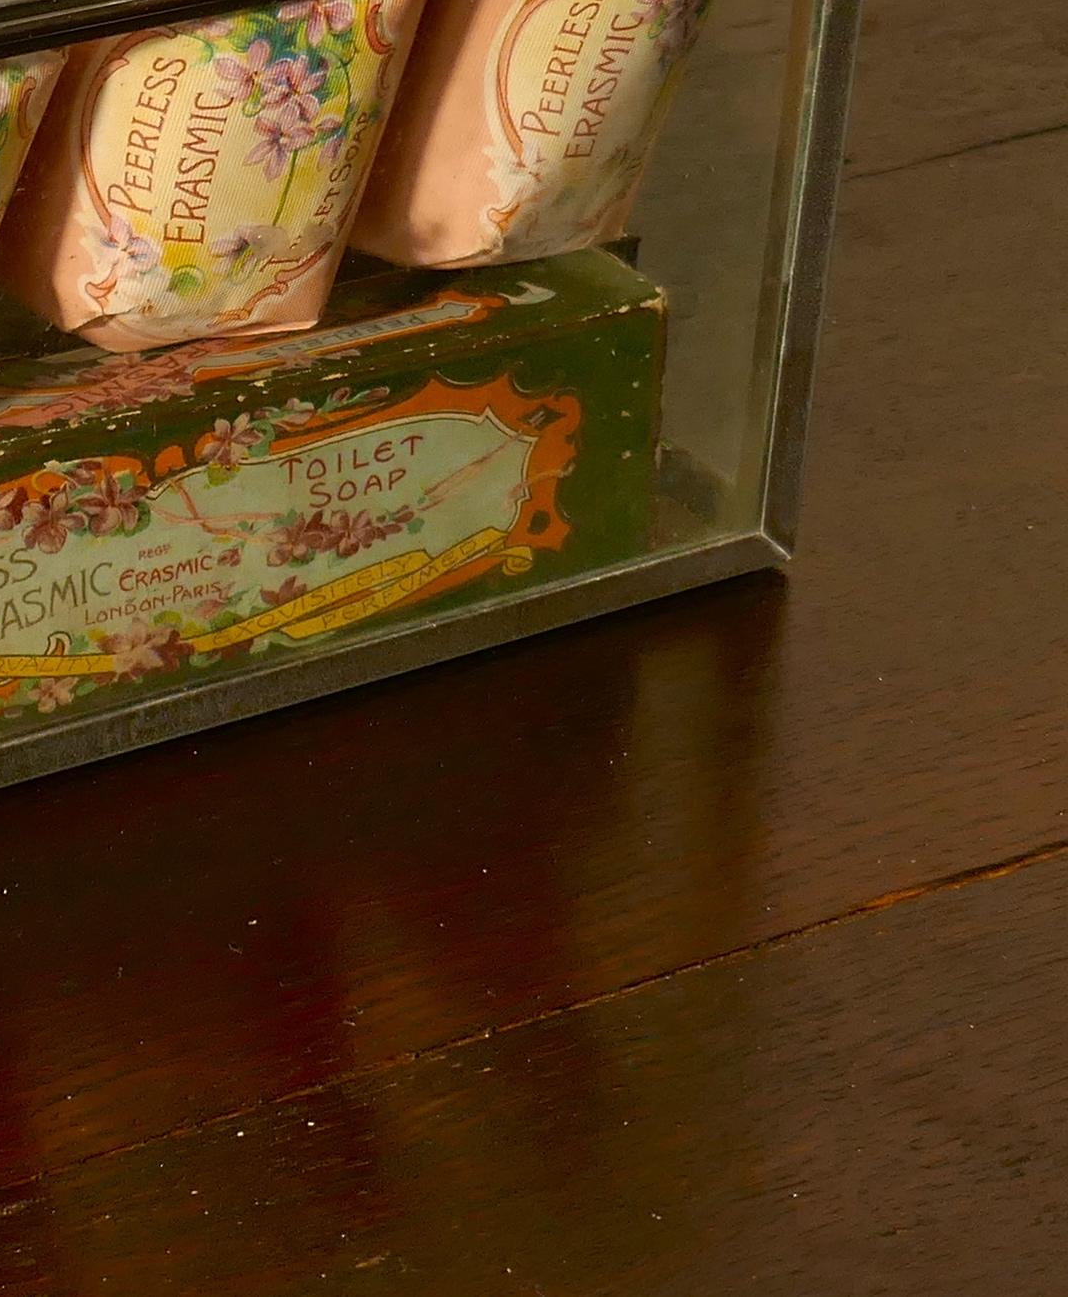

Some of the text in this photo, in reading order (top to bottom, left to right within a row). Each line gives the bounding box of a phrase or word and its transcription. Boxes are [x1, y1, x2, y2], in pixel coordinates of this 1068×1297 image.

[564, 14, 645, 159] ERASMIC
[107, 56, 187, 215] PEERLESS
[163, 91, 236, 246] ERASMIC
[279, 435, 425, 485] TOILET
[308, 468, 407, 509] SOAP
[118, 555, 213, 592] ERASMIC
